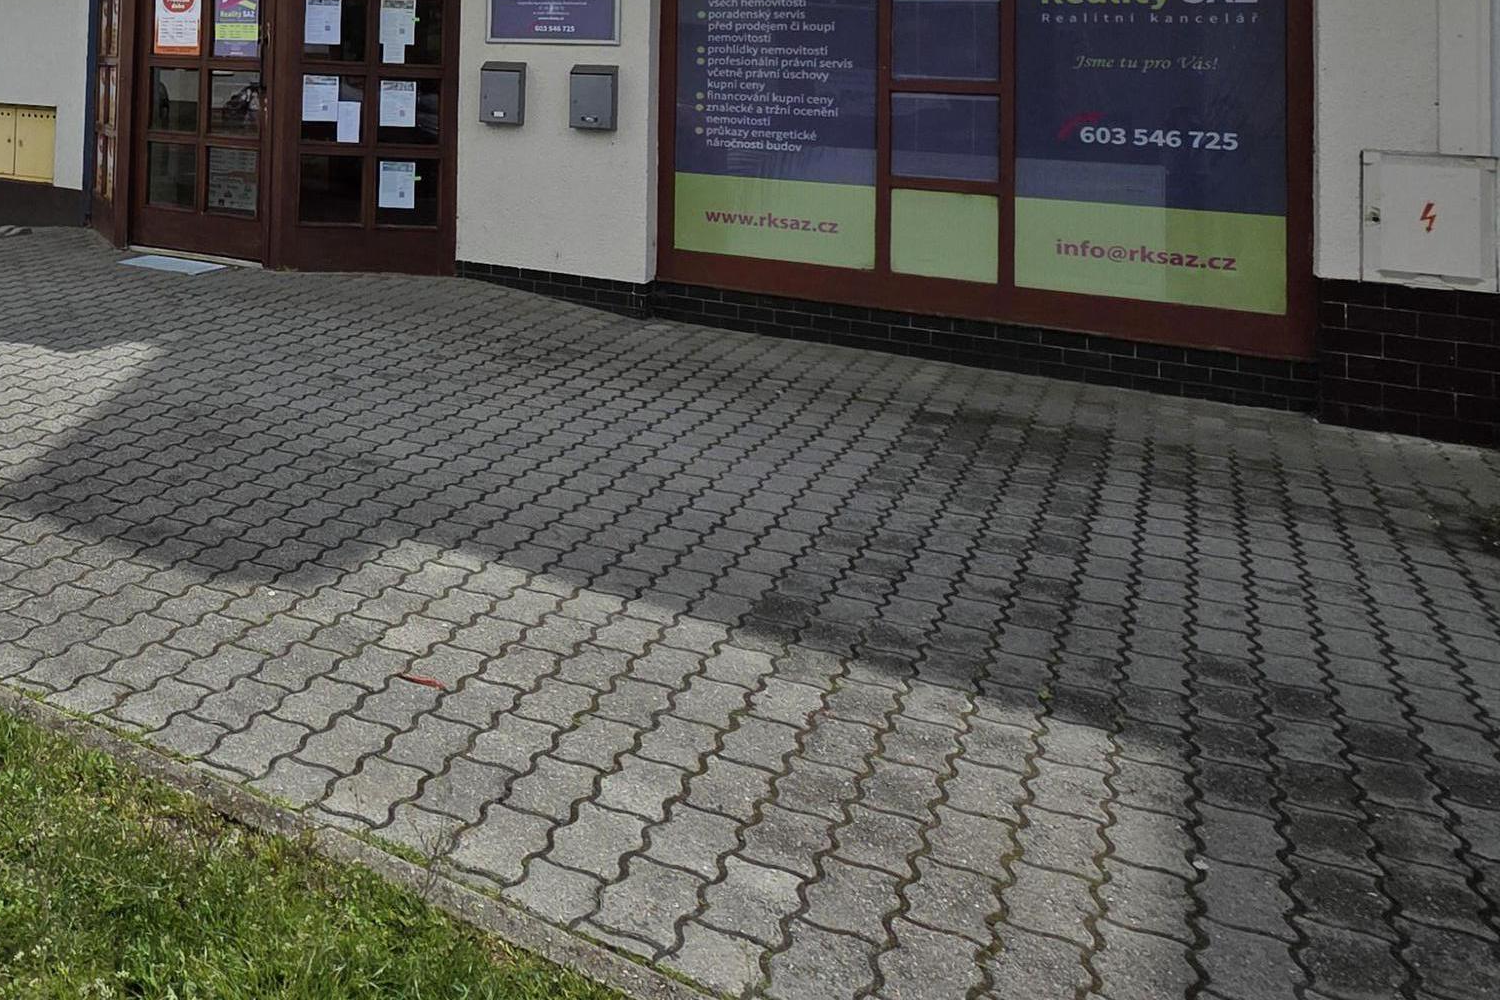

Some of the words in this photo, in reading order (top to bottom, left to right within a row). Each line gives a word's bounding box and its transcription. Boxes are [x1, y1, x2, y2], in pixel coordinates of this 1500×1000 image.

[708, 9, 772, 21] poradenský
[773, 10, 806, 20] servis
[1041, 12, 1135, 23] Realitní
[1150, 13, 1260, 24] kancelář
[708, 21, 733, 32] před
[734, 21, 788, 33] prodejem
[790, 21, 800, 31] či
[707, 32, 772, 43] nemovitostí
[707, 44, 758, 56] prohlídky
[760, 45, 828, 56] nemovitostí
[707, 56, 779, 68] profesionální
[781, 57, 817, 69] právní
[819, 58, 853, 69] servis
[1073, 55, 1114, 70] Jsme
[1120, 57, 1139, 69] tu
[1142, 59, 1172, 74] pro
[1177, 56, 1219, 71] Vás!
[707, 67, 743, 78] včetně
[745, 68, 780, 80] právní
[783, 70, 829, 82] úschovy
[707, 79, 737, 91] kupní
[740, 81, 766, 92] ceny
[707, 90, 770, 102] financování
[772, 92, 805, 105] kupní
[806, 95, 835, 107] ceny
[706, 102, 754, 114] znalecké
[756, 105, 763, 114] a
[765, 104, 791, 116] tržní
[793, 106, 839, 118] ocenění
[706, 115, 771, 126] nemovitostí
[706, 125, 750, 139] průkazy
[751, 129, 817, 142] energetické
[1080, 126, 1126, 145] 603
[1132, 129, 1182, 148] 546
[1188, 131, 1239, 151] 725
[706, 137, 764, 149] náročnosti
[765, 140, 802, 152] budov
[705, 211, 839, 234] www.rksaz.cz
[1056, 239, 1237, 271] info@rksaz.cz
